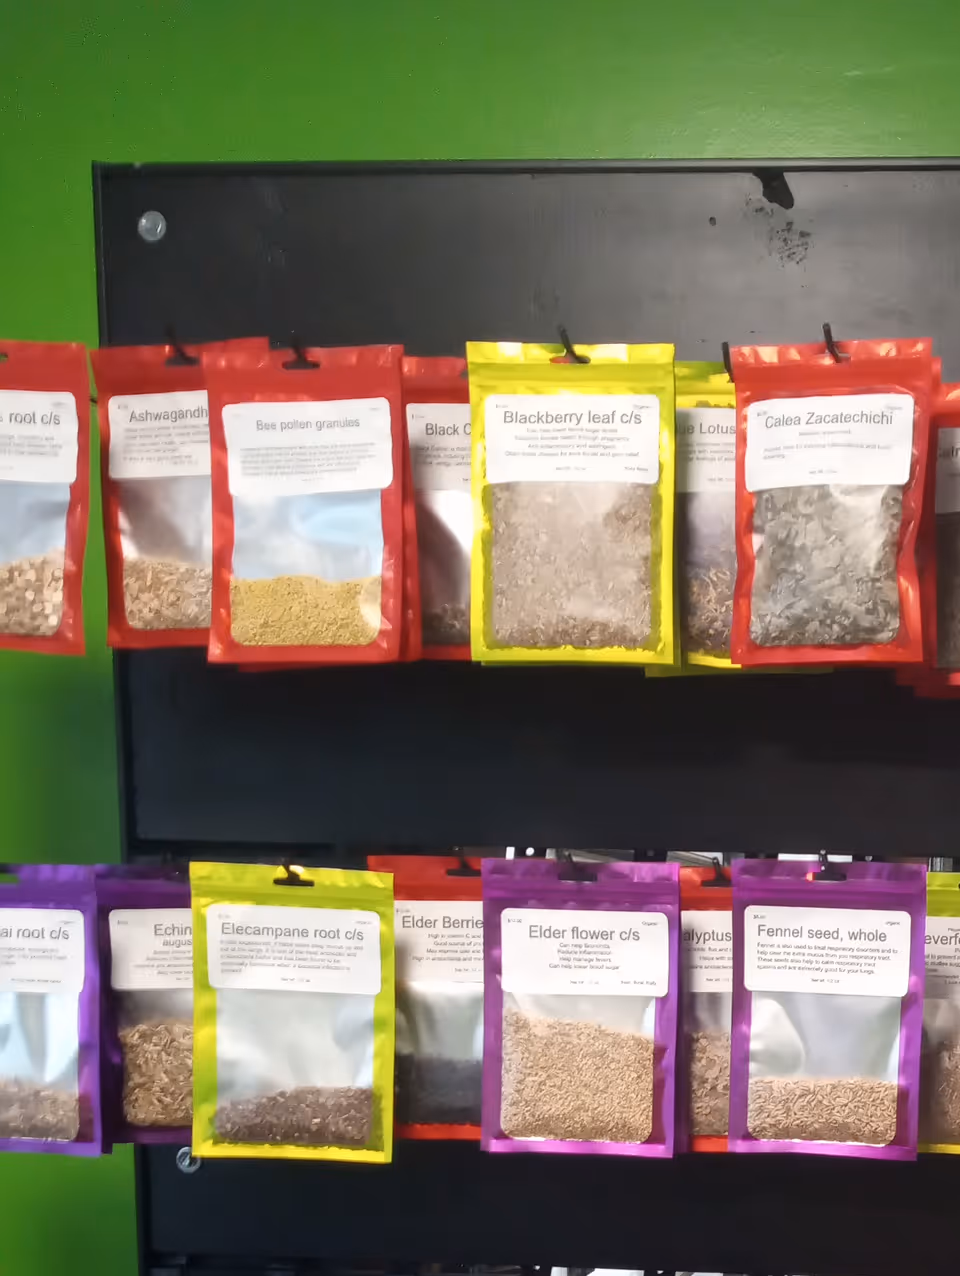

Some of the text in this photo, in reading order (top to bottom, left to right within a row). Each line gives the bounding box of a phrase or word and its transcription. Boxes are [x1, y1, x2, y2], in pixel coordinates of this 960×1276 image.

[9, 411, 61, 425] root c/s
[256, 417, 360, 432] Bee pollen granules
[503, 410, 643, 426] Blackberry leaf c/s
[765, 410, 893, 428] Calea Zacatechichi
[425, 422, 460, 436] Black
[699, 422, 736, 435] Lotus
[402, 915, 439, 929] Elder
[16, 926, 45, 939] root
[49, 926, 70, 940] c/s
[221, 922, 365, 941] Elecampane root c/s
[528, 925, 641, 942] Elder flower c/s
[757, 924, 887, 942] Fennel seed, whole
